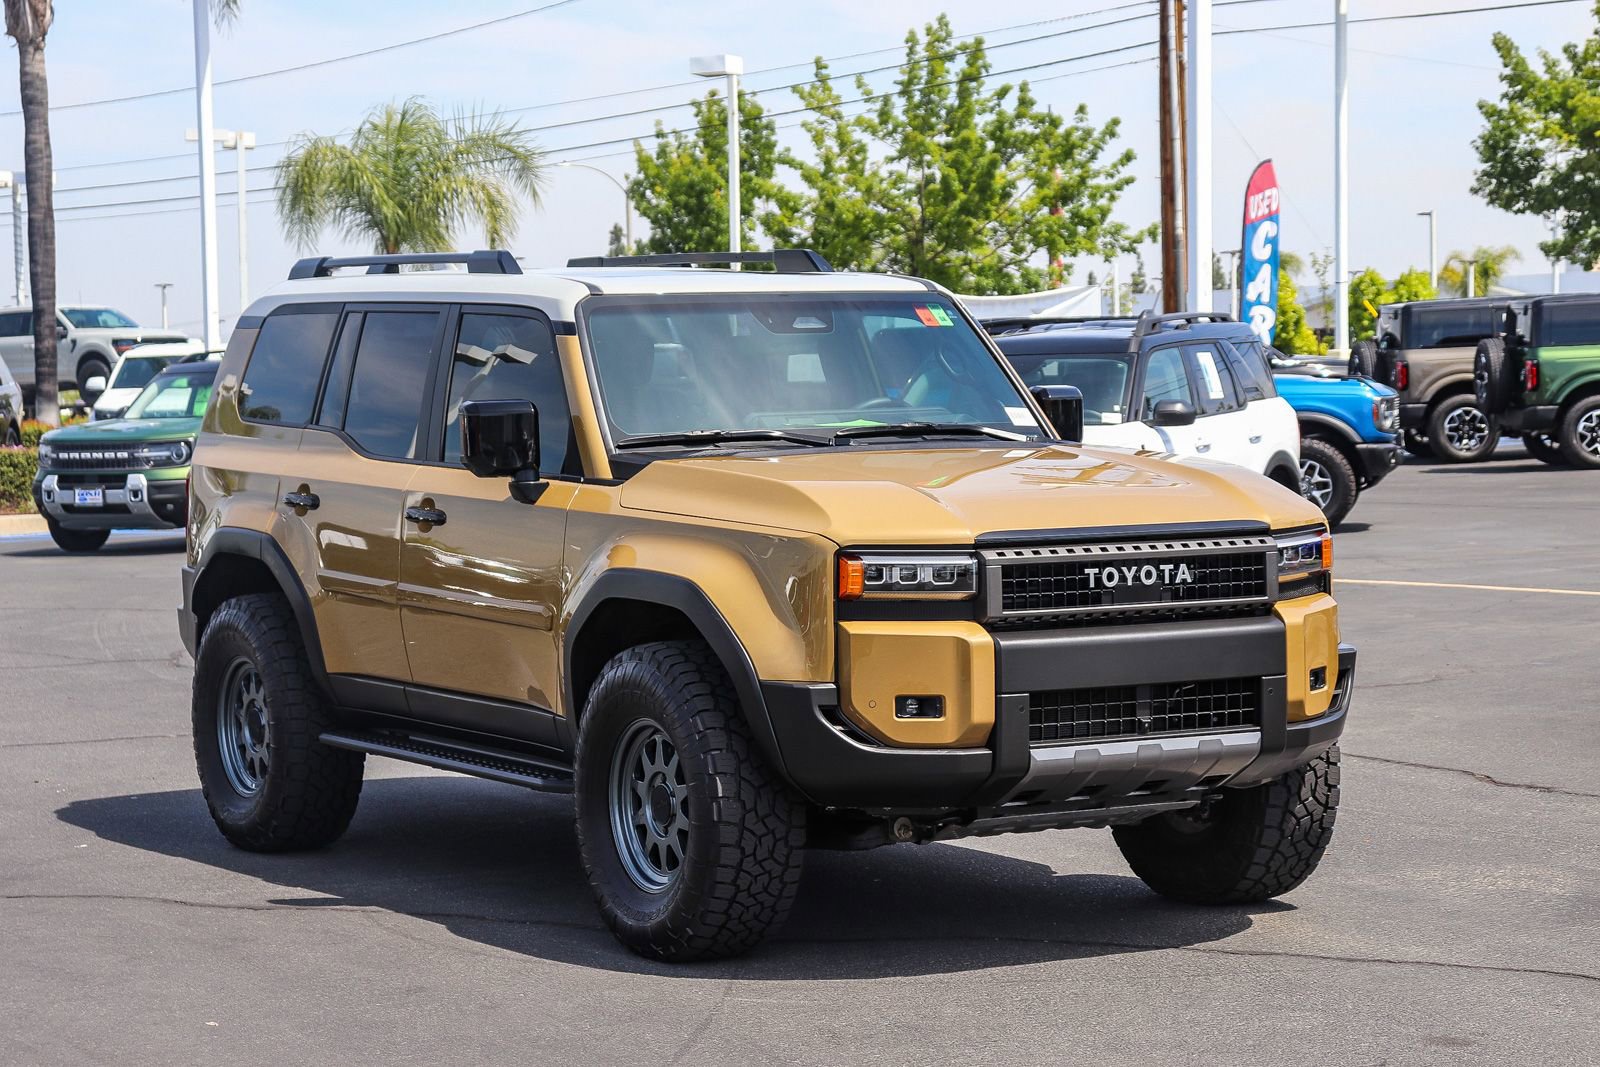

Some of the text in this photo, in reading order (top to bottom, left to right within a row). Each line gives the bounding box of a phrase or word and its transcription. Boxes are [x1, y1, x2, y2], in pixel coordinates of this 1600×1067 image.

[1249, 187, 1279, 219] USED
[58, 452, 128, 460] BRONCO
[1084, 563, 1193, 588] TOYOTA
